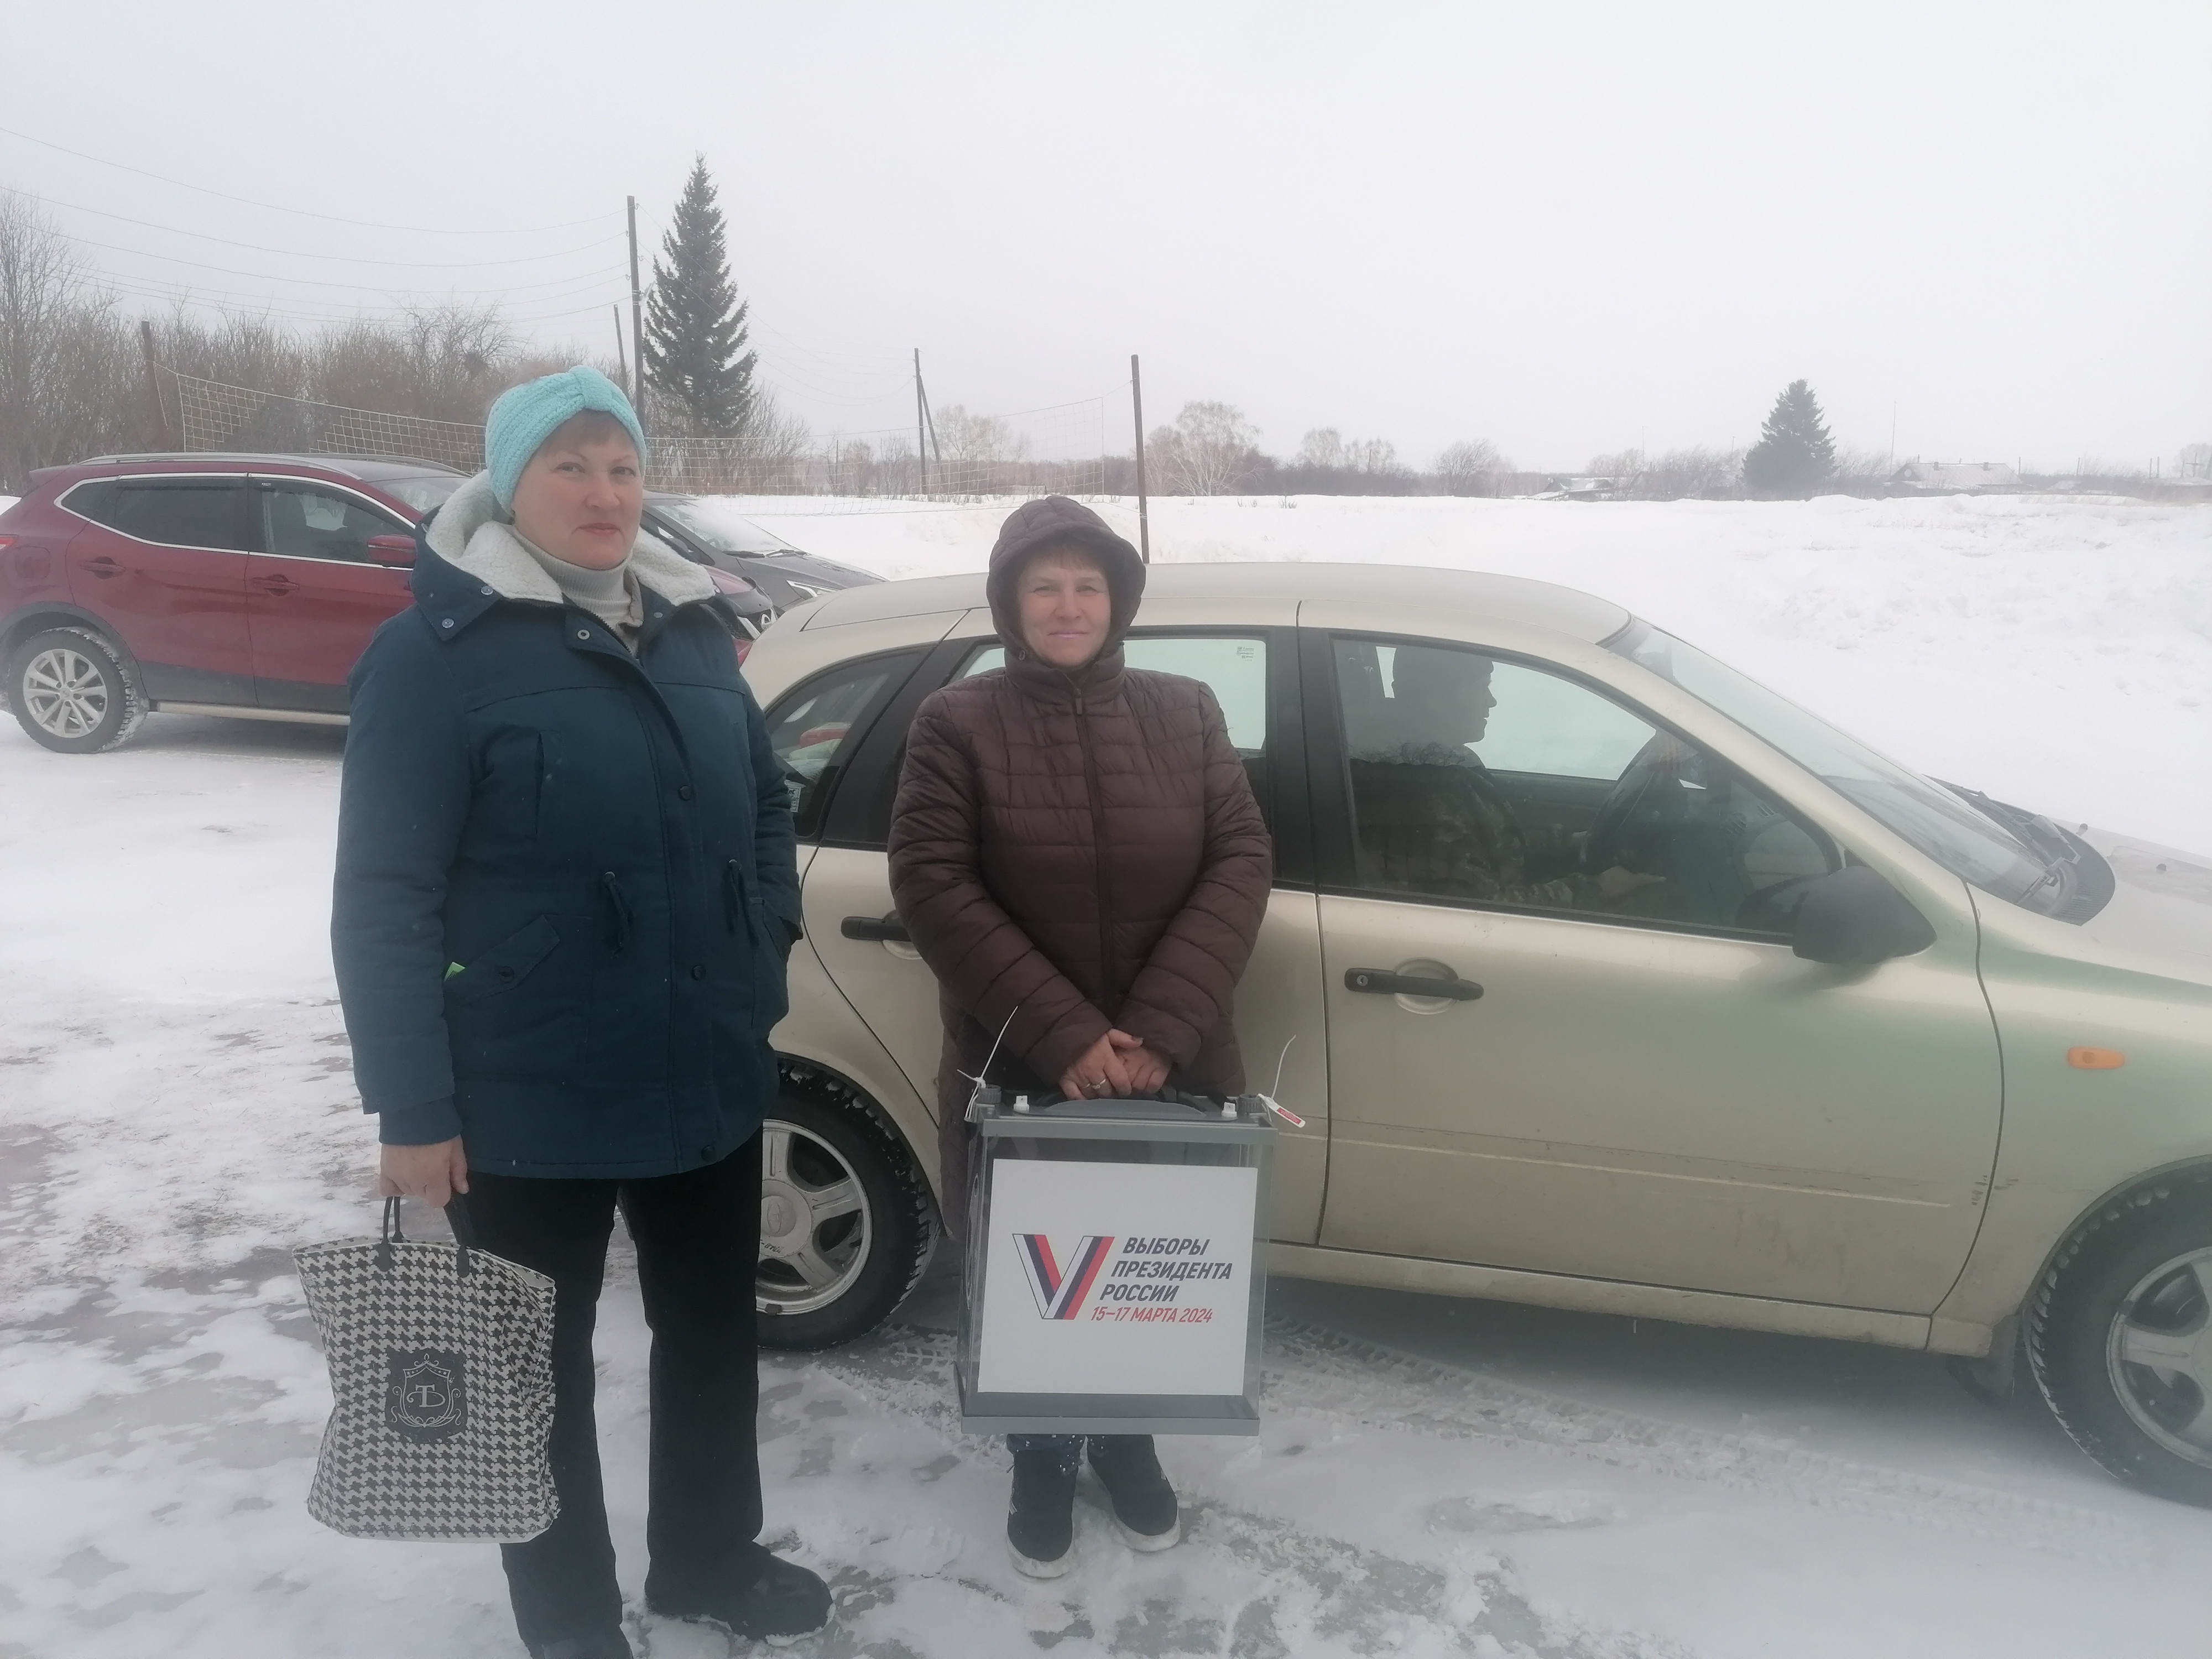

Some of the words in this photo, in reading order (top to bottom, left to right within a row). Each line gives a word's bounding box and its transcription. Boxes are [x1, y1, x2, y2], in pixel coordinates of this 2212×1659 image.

[1122, 1237, 1211, 1255] ВЫБОРЫ
[1110, 1260, 1233, 1281] ПРЕЗИДЕНТА
[1099, 1284, 1180, 1302] РОССИИ
[1091, 1306, 1131, 1322] 15–17
[1129, 1307, 1178, 1323] МАРТА
[1178, 1308, 1213, 1323] 2024
